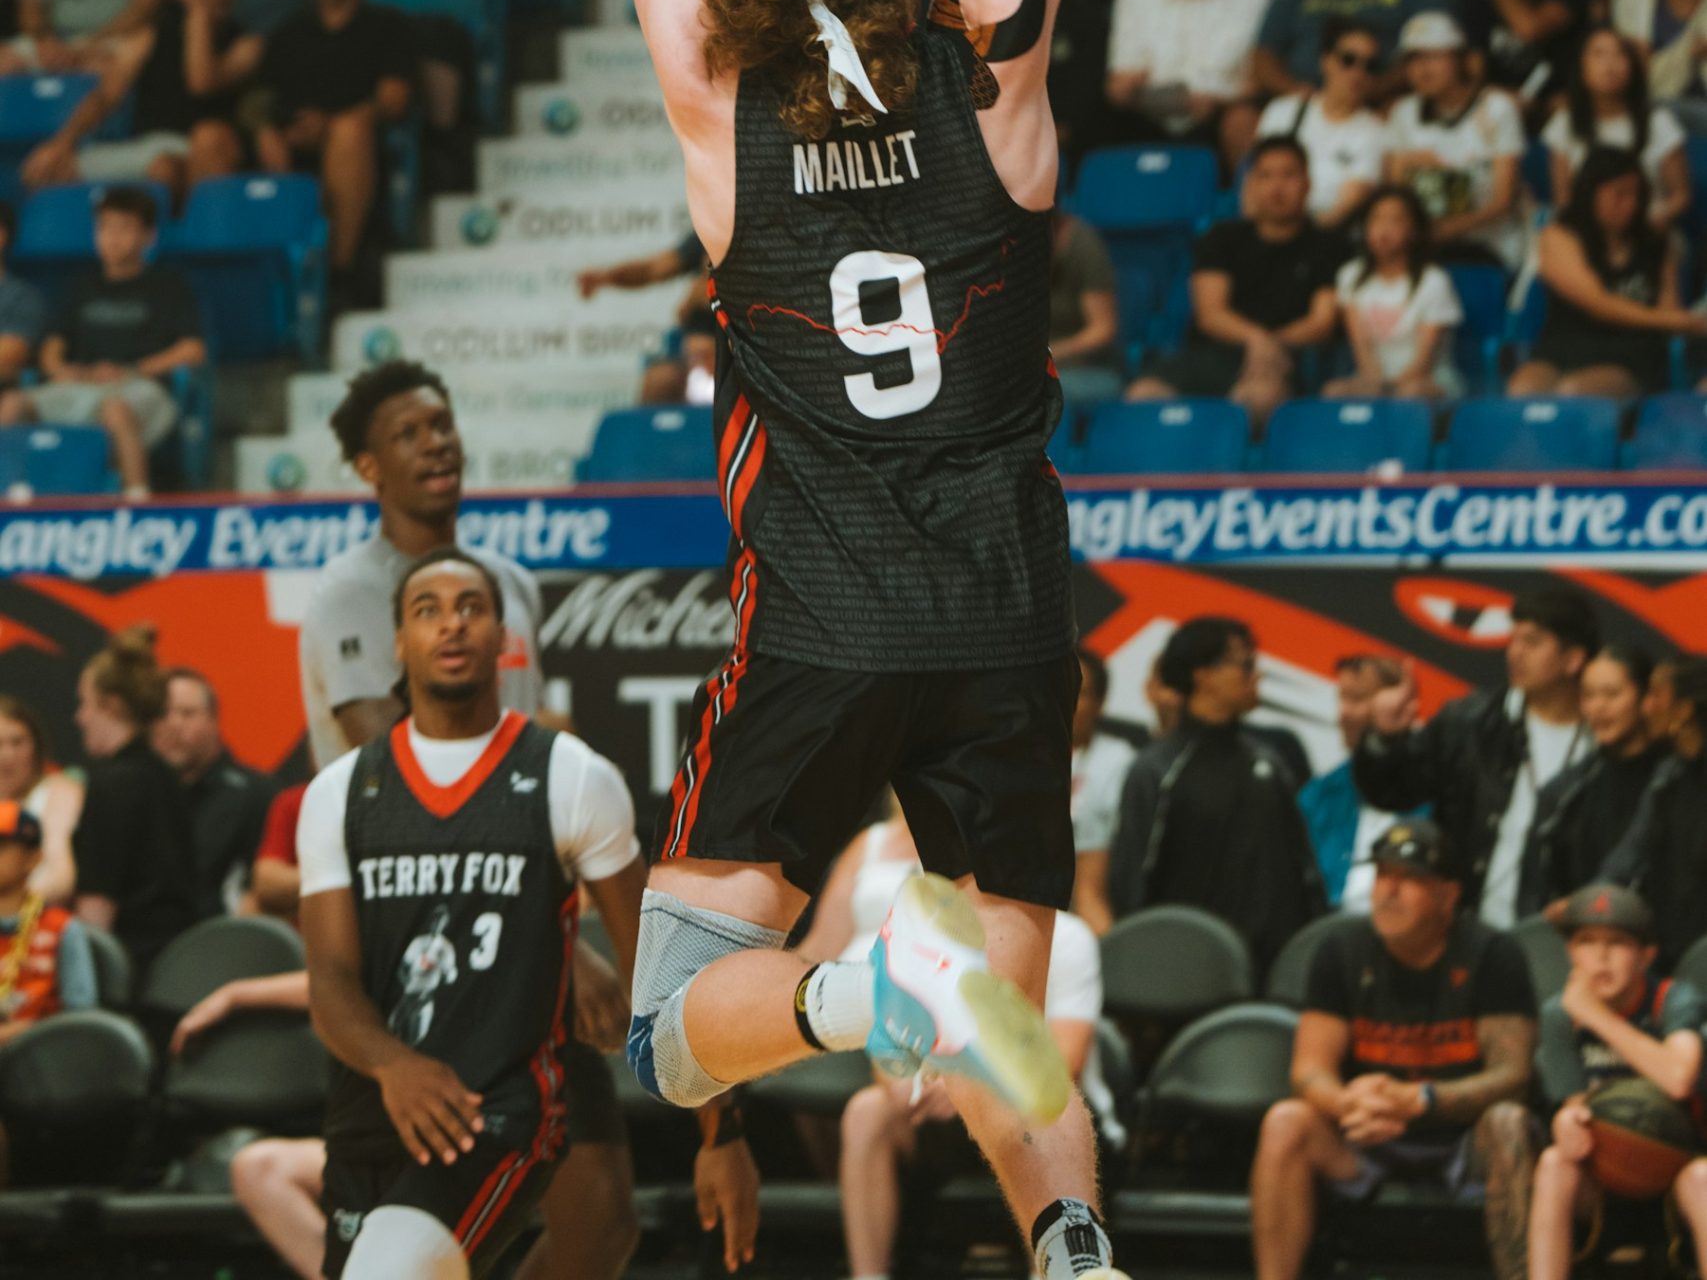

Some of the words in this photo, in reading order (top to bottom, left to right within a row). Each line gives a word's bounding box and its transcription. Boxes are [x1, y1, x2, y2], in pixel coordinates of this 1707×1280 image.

[793, 130, 921, 195] MAILLET
[829, 250, 942, 420] 9
[0, 507, 197, 579] angley
[208, 506, 381, 568] Event
[456, 500, 610, 562] entre
[1069, 487, 1707, 561] ngleyEventsCentre.co
[538, 568, 736, 649] Miche
[358, 853, 459, 900] TERRY
[461, 851, 527, 896] FOX
[469, 911, 503, 970] 3
